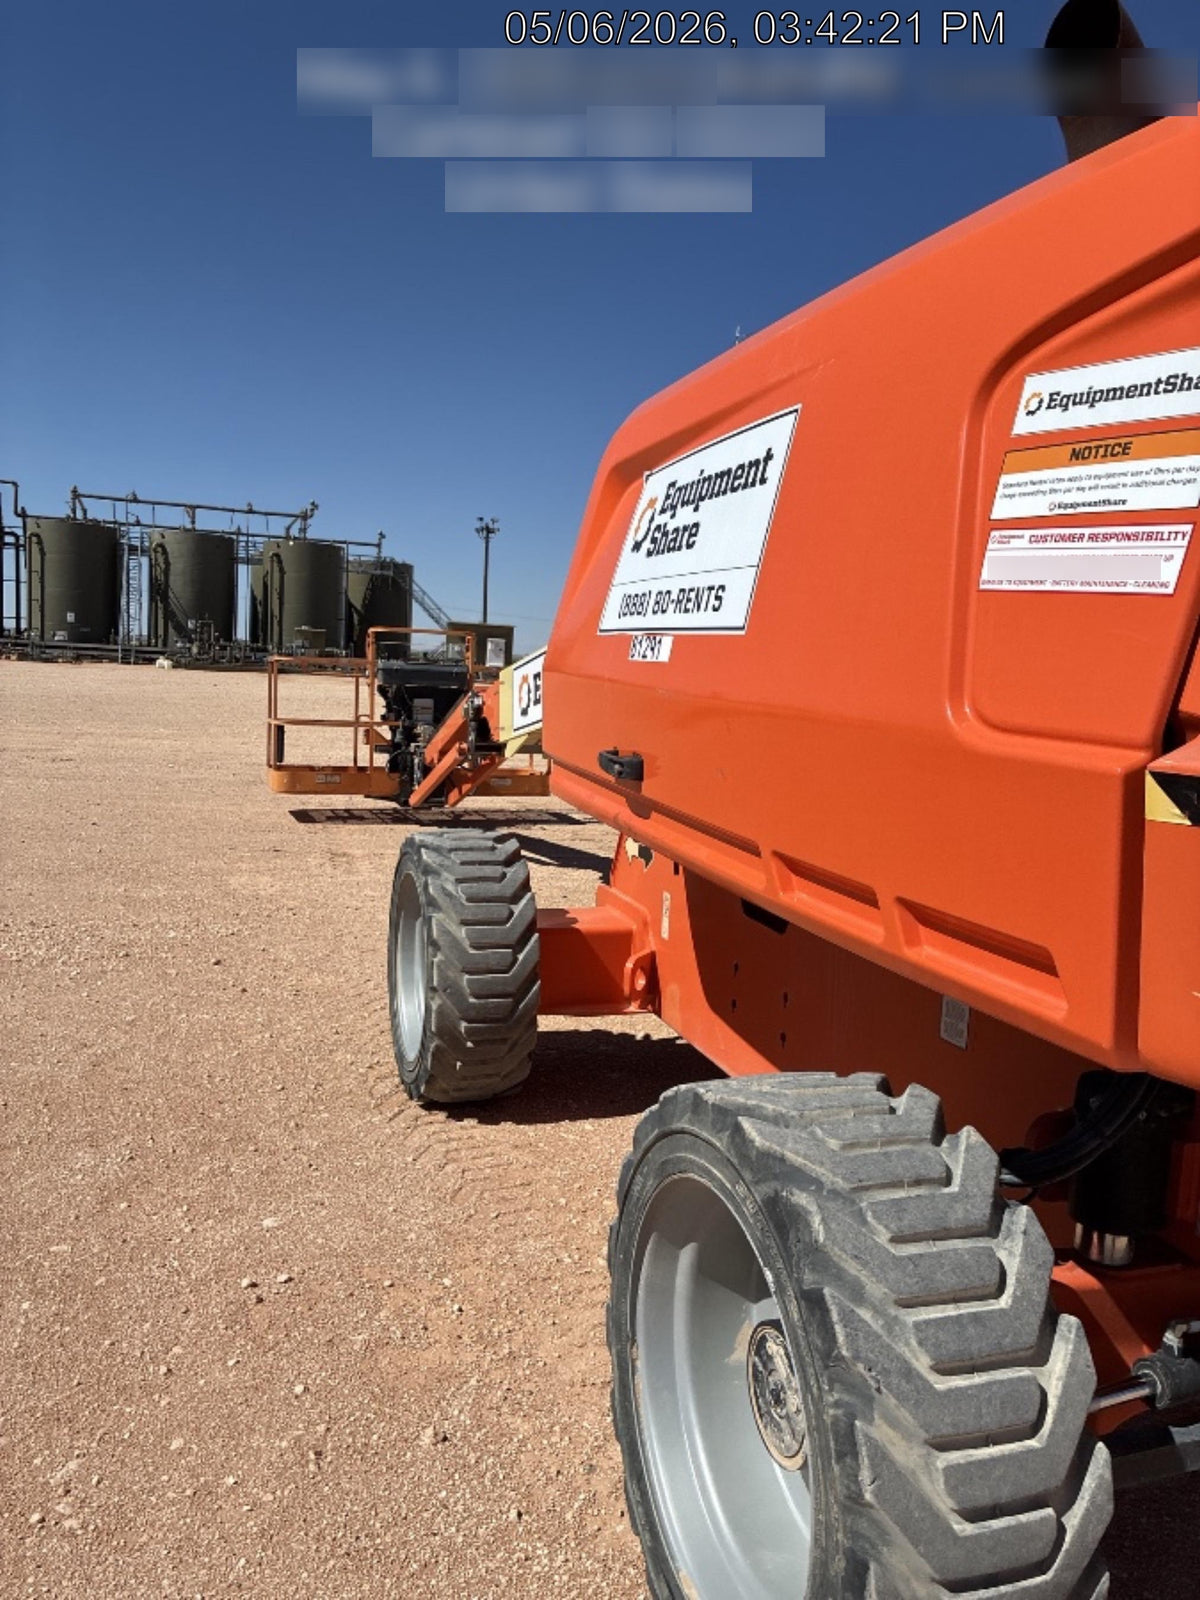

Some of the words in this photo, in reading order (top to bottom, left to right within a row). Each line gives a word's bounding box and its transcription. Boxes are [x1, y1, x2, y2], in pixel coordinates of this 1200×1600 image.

[1068, 440, 1133, 462] NOTICE
[658, 446, 774, 519] Equipment
[645, 521, 700, 558] Share
[1028, 532, 1085, 545] CUSTOMER
[1086, 530, 1189, 543] RESPONSIBILITY
[618, 589, 652, 620] (888)
[651, 584, 726, 616] 80-RENTS
